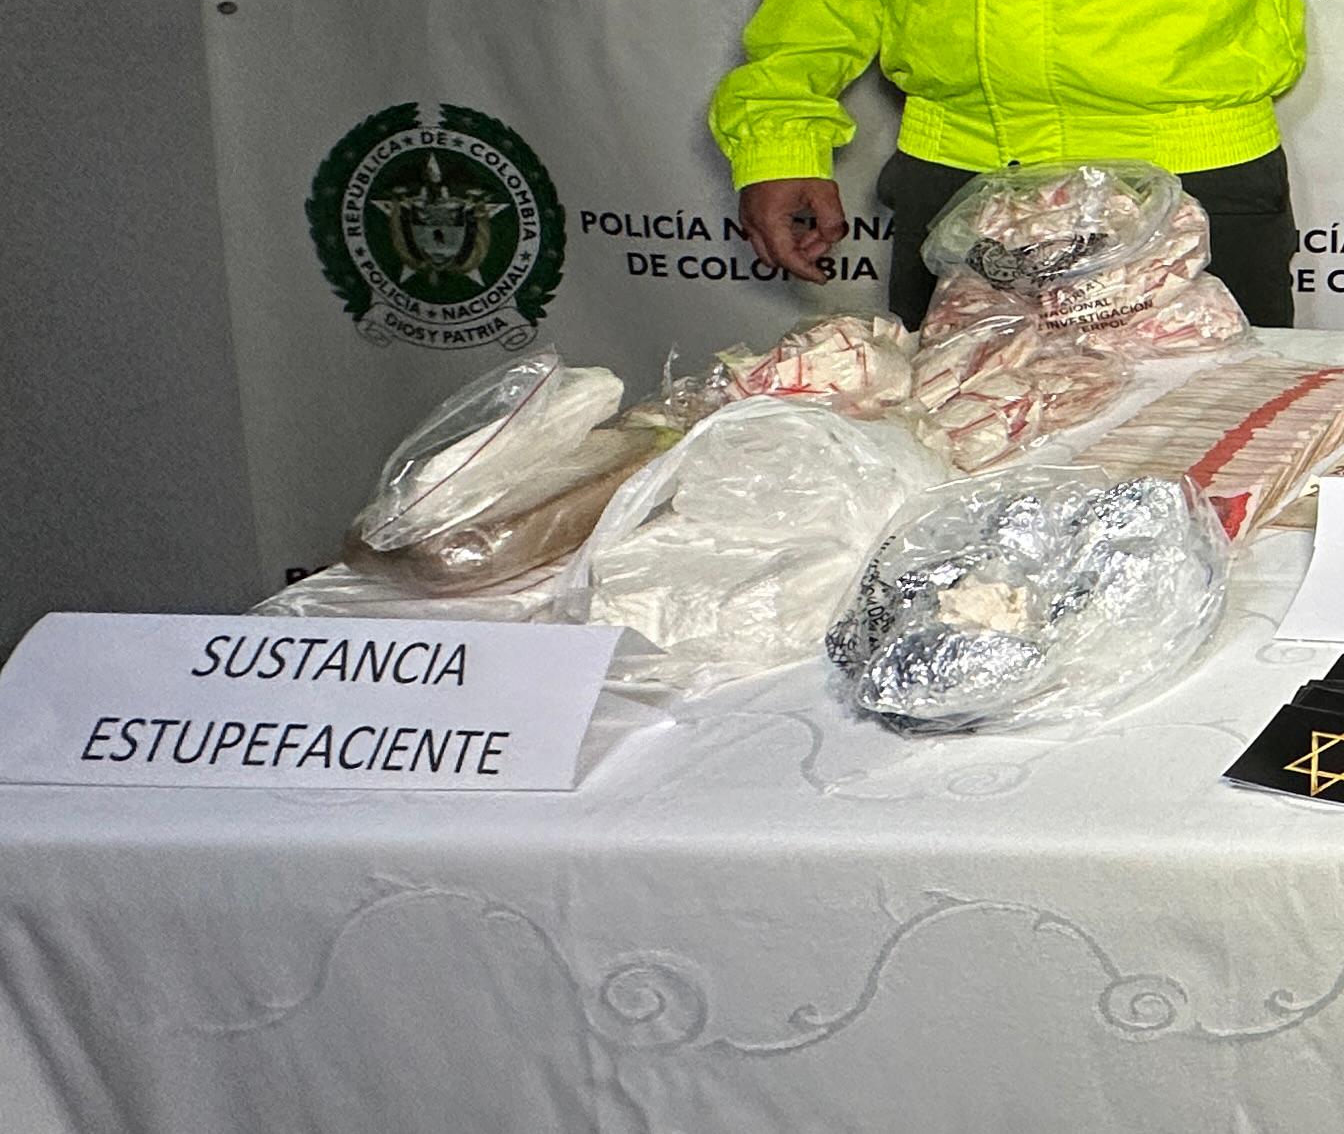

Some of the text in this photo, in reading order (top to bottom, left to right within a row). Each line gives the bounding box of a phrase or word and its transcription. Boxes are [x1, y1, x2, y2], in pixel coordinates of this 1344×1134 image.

[581, 210, 711, 240] POLICÍA
[627, 253, 668, 277] DE
[192, 635, 465, 686] SUSTANCIA
[81, 717, 509, 774] ESTUPEFACIENTE
